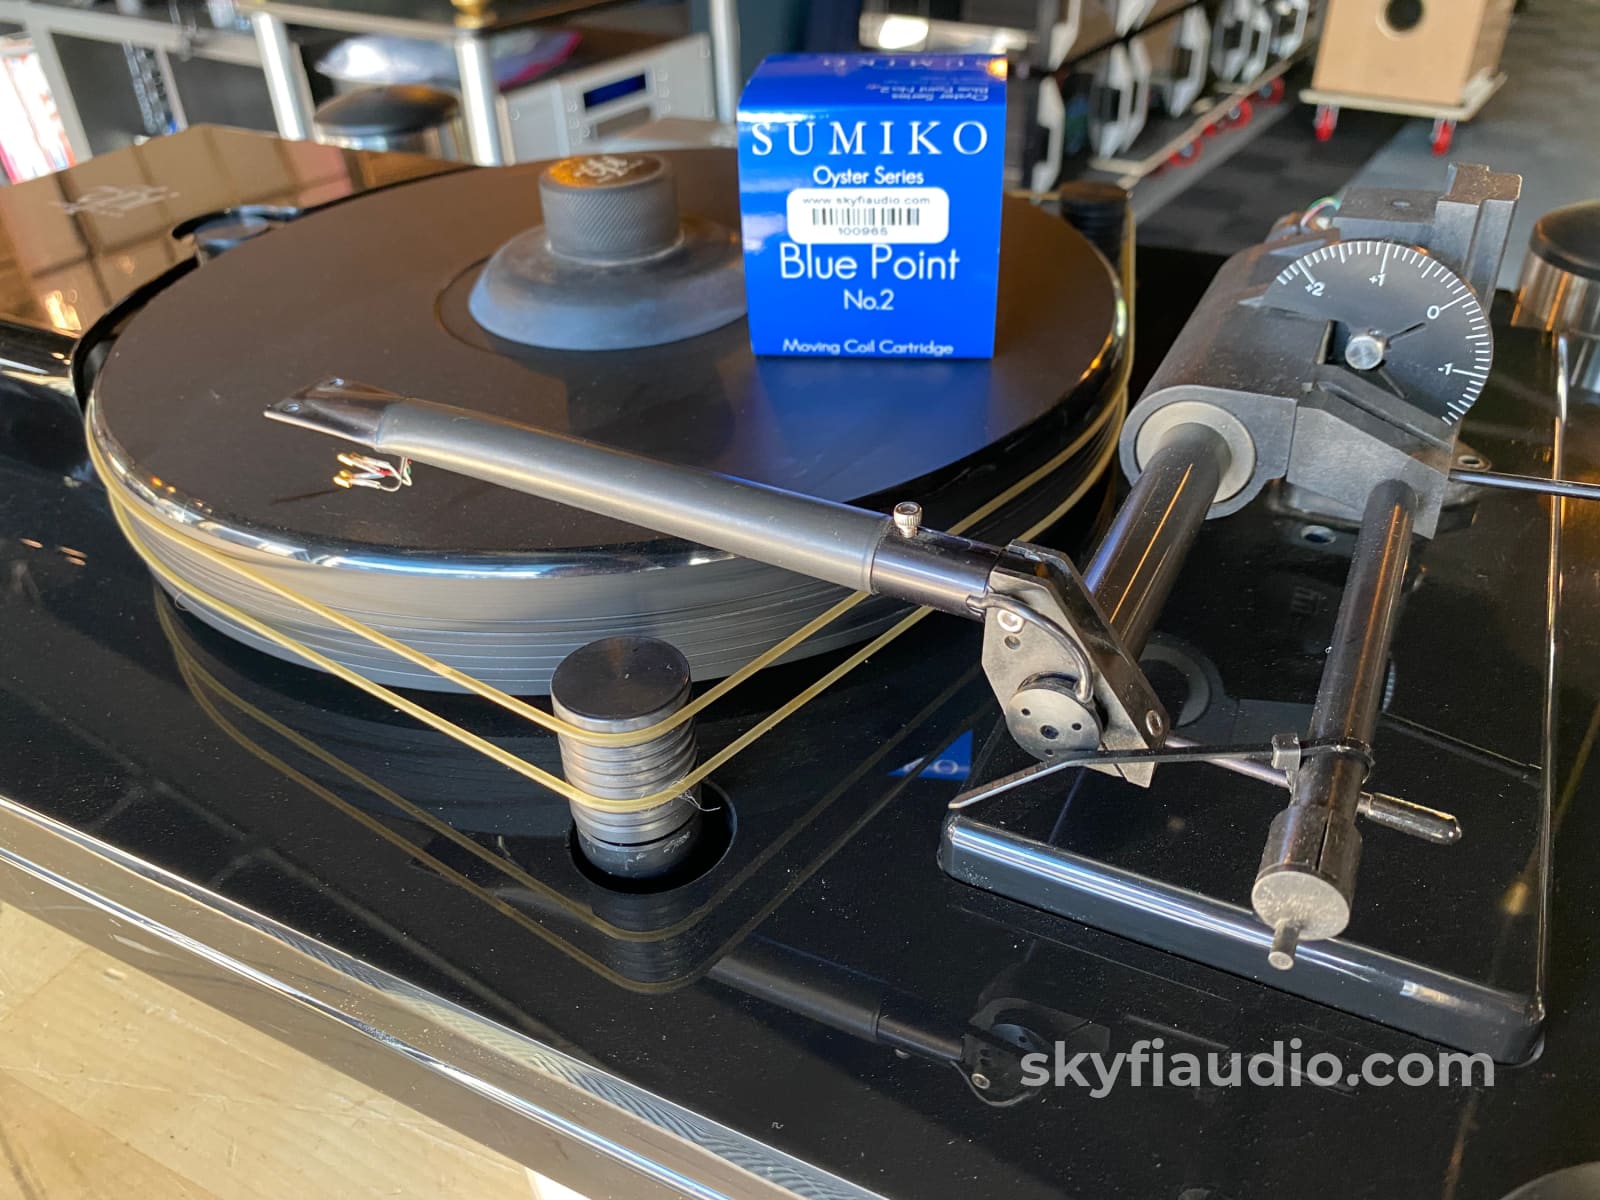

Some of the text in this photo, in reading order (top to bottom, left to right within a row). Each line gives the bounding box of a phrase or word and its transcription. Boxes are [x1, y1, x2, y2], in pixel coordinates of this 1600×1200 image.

[750, 120, 989, 156] SUMIKO
[812, 165, 925, 188] Oyster Series
[779, 242, 961, 281] Blue Point
[1368, 272, 1386, 287] +1
[1304, 281, 1326, 298] +2
[843, 288, 895, 311] No.2
[1426, 305, 1441, 320] 0
[782, 338, 954, 357] Moving Coil Cartridge
[1437, 363, 1454, 376] -1
